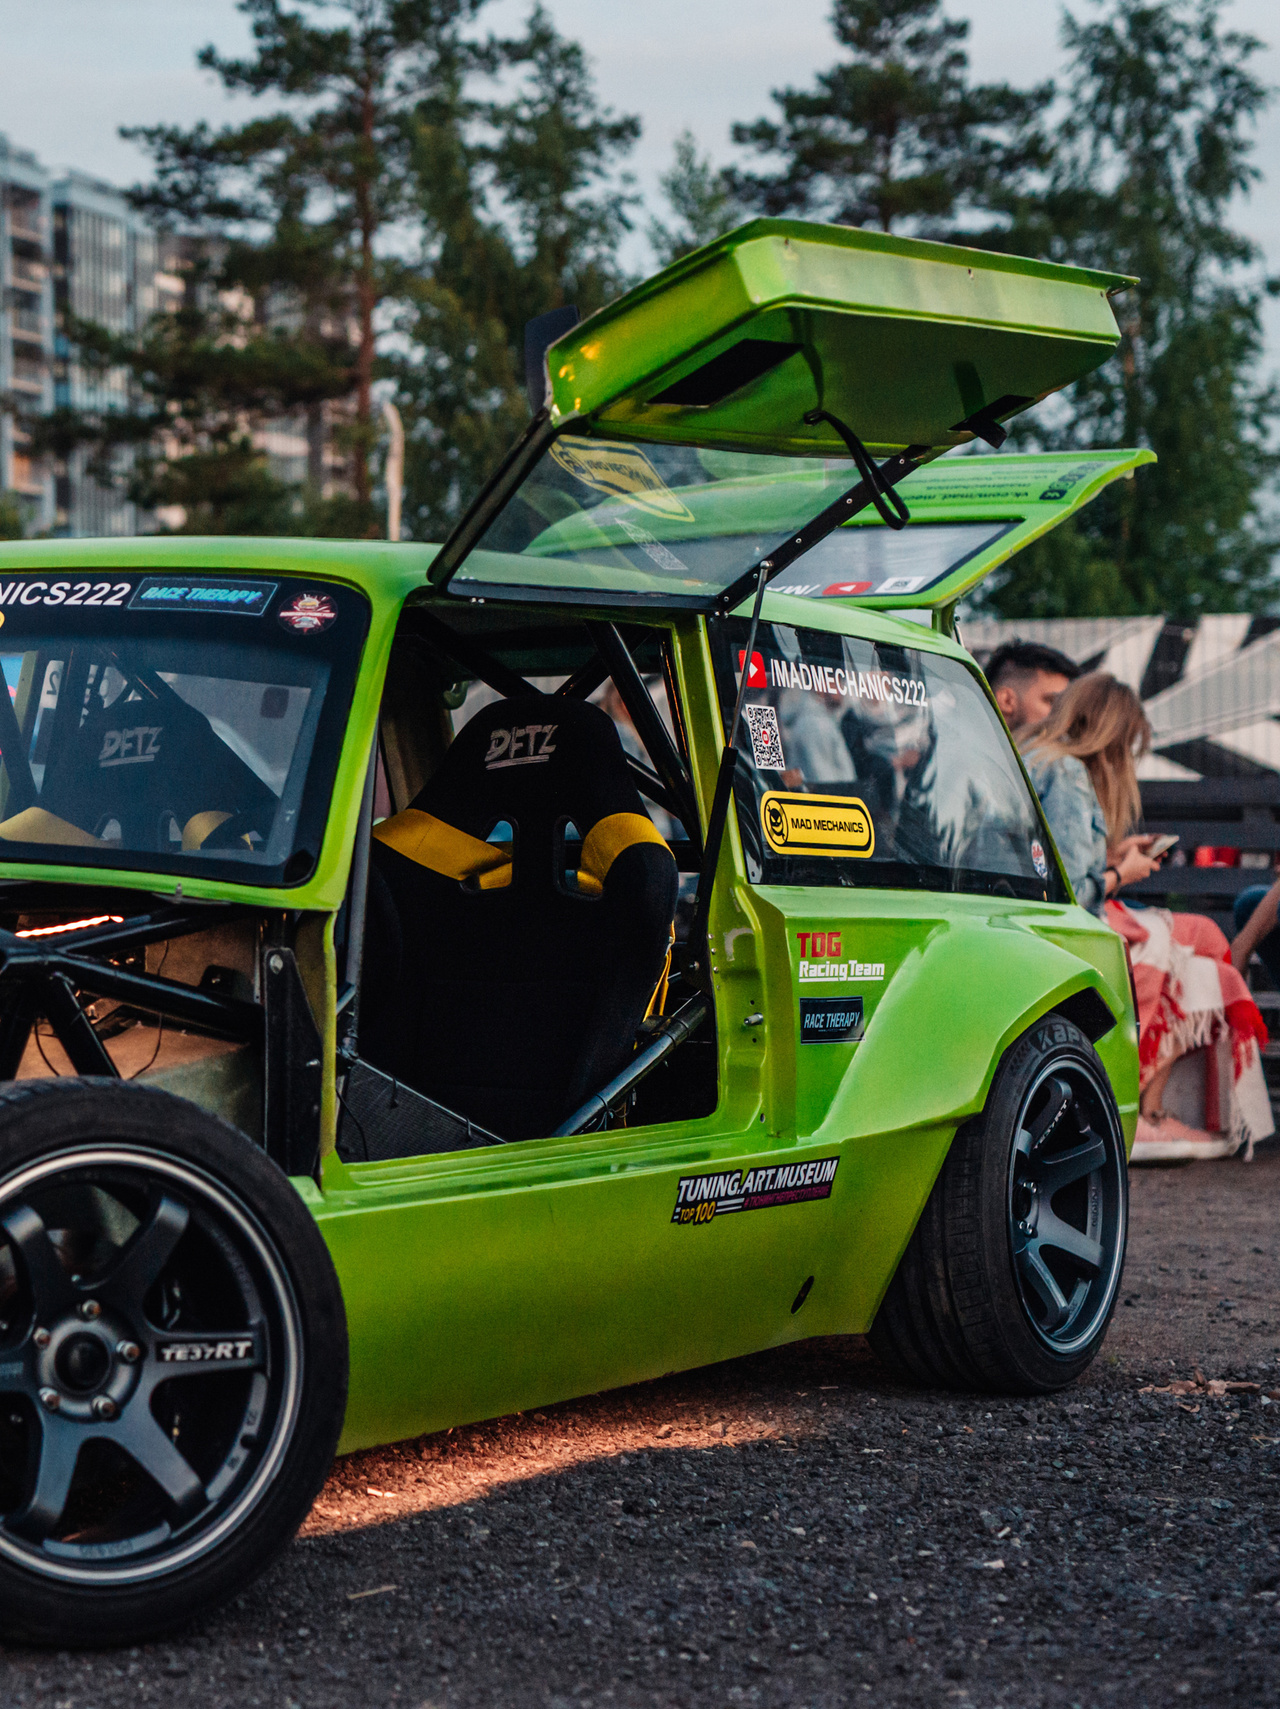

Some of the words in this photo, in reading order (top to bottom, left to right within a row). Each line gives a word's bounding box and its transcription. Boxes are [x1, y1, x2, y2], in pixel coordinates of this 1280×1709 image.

[140, 586, 189, 600] RACE
[185, 587, 264, 605] THERAPY
[790, 817, 813, 831] MAD
[814, 818, 864, 834] MECHANICS
[796, 931, 842, 958] TDG
[804, 1013, 825, 1029] RACE
[826, 1012, 860, 1028] THERAPY
